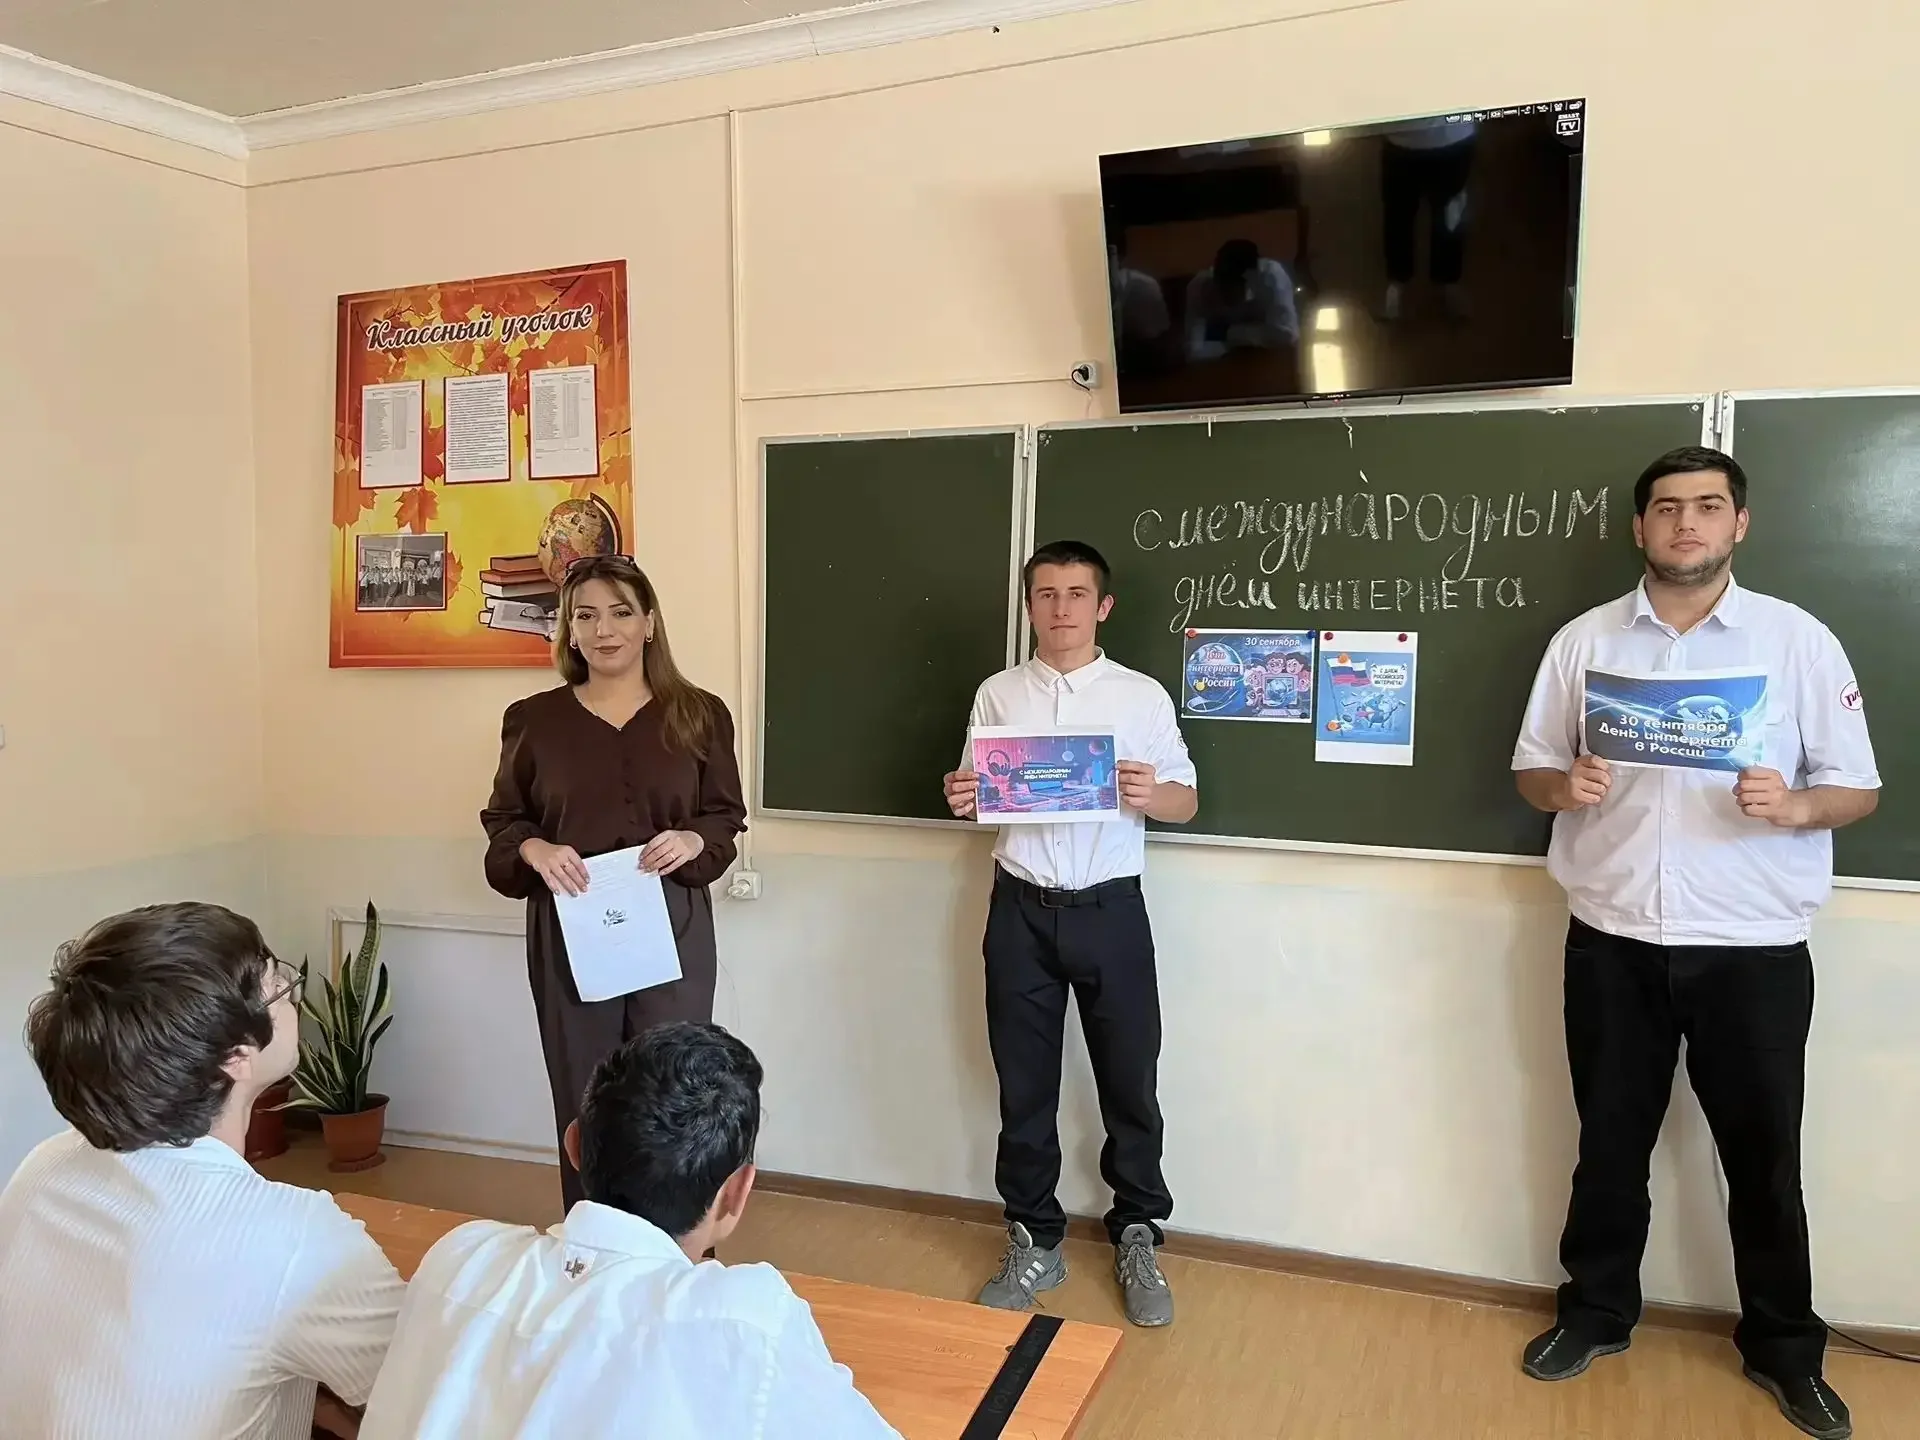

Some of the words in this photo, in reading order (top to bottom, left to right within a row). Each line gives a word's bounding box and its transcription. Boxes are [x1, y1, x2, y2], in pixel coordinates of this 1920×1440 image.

[1560, 121, 1576, 131] TV
[367, 312, 493, 350] Классный
[501, 304, 593, 343] уголок
[1244, 637, 1258, 646] 30
[1259, 635, 1301, 648] сентября
[1191, 664, 1240, 676] интернета
[1202, 676, 1237, 688] России
[1620, 714, 1639, 727] 30
[1644, 719, 1727, 734] сентября
[1598, 722, 1639, 739] День
[1645, 731, 1748, 747] интернета
[1634, 741, 1645, 751] в
[1649, 742, 1706, 758] России
